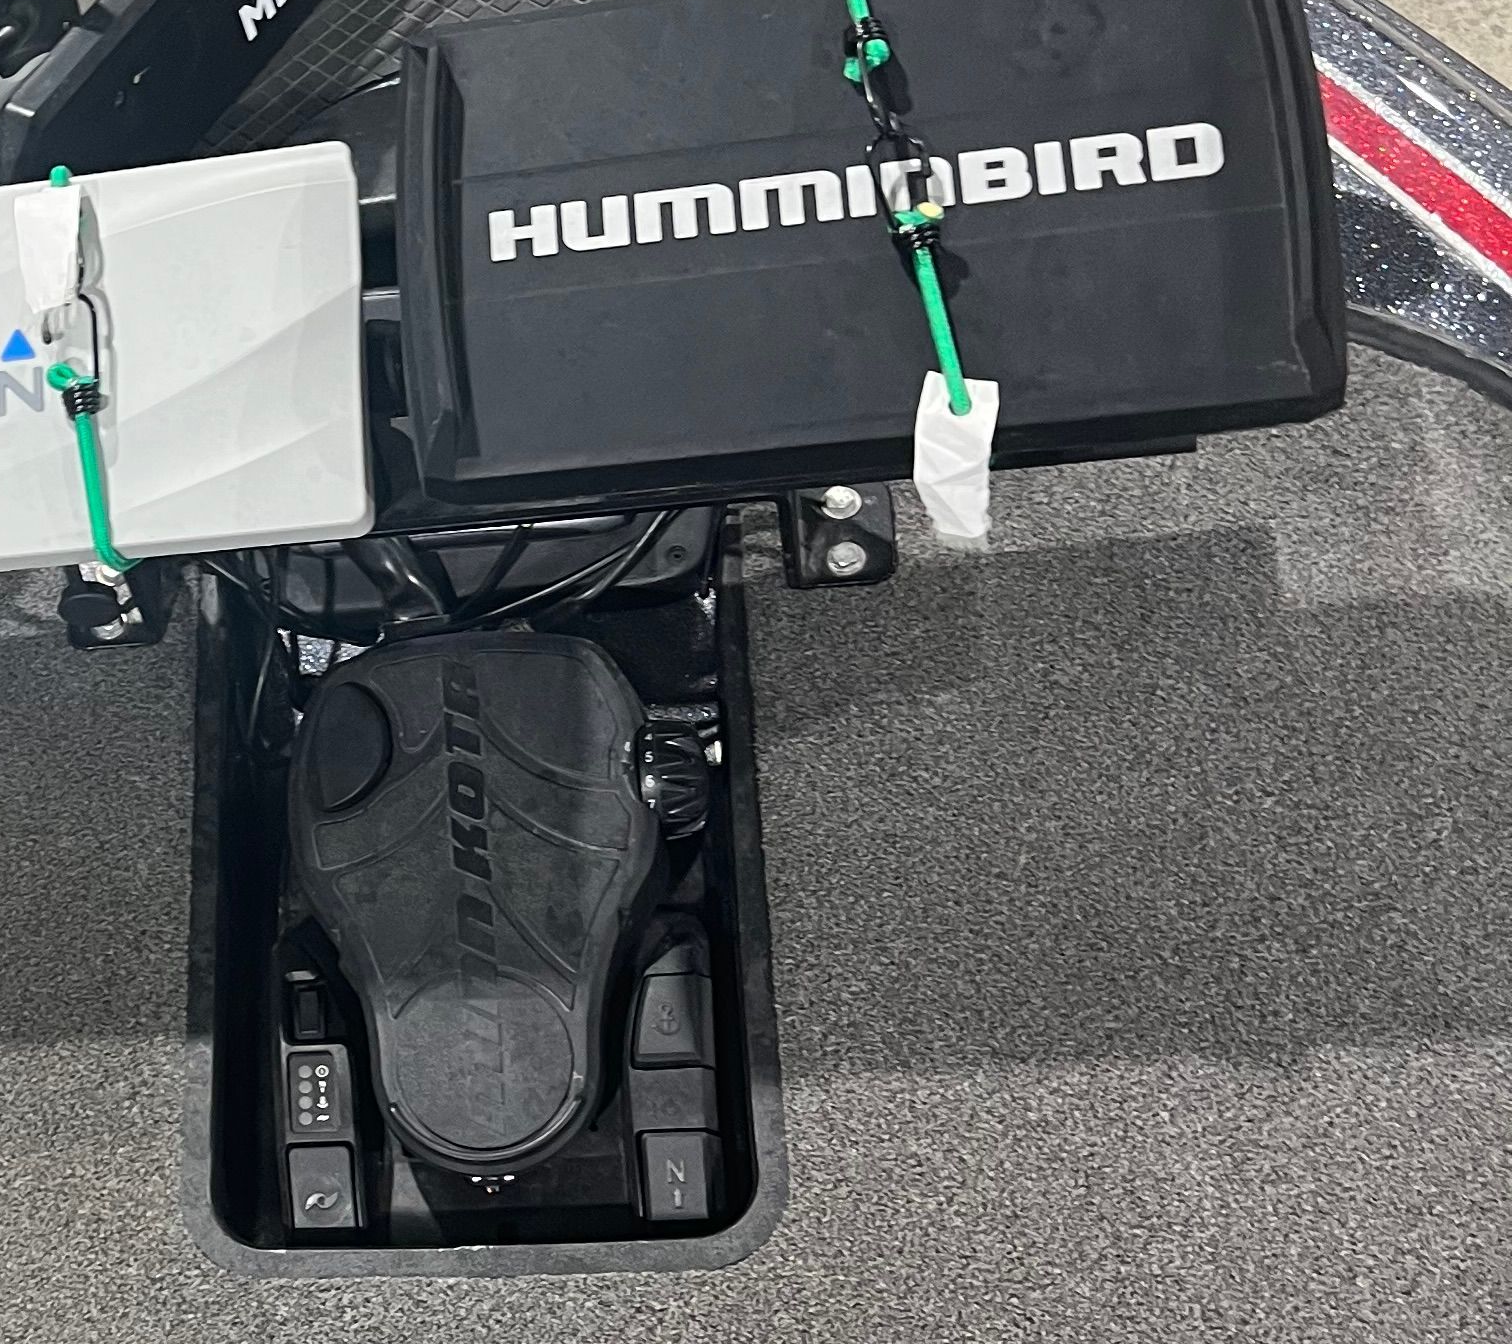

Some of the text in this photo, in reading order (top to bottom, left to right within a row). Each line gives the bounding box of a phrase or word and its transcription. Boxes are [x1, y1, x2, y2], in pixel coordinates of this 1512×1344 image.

[488, 122, 1225, 262] HUMMINBIRD
[644, 751, 654, 763] 5
[645, 774, 656, 788] 6
[647, 798, 656, 809] 7
[666, 1159, 687, 1184] N
